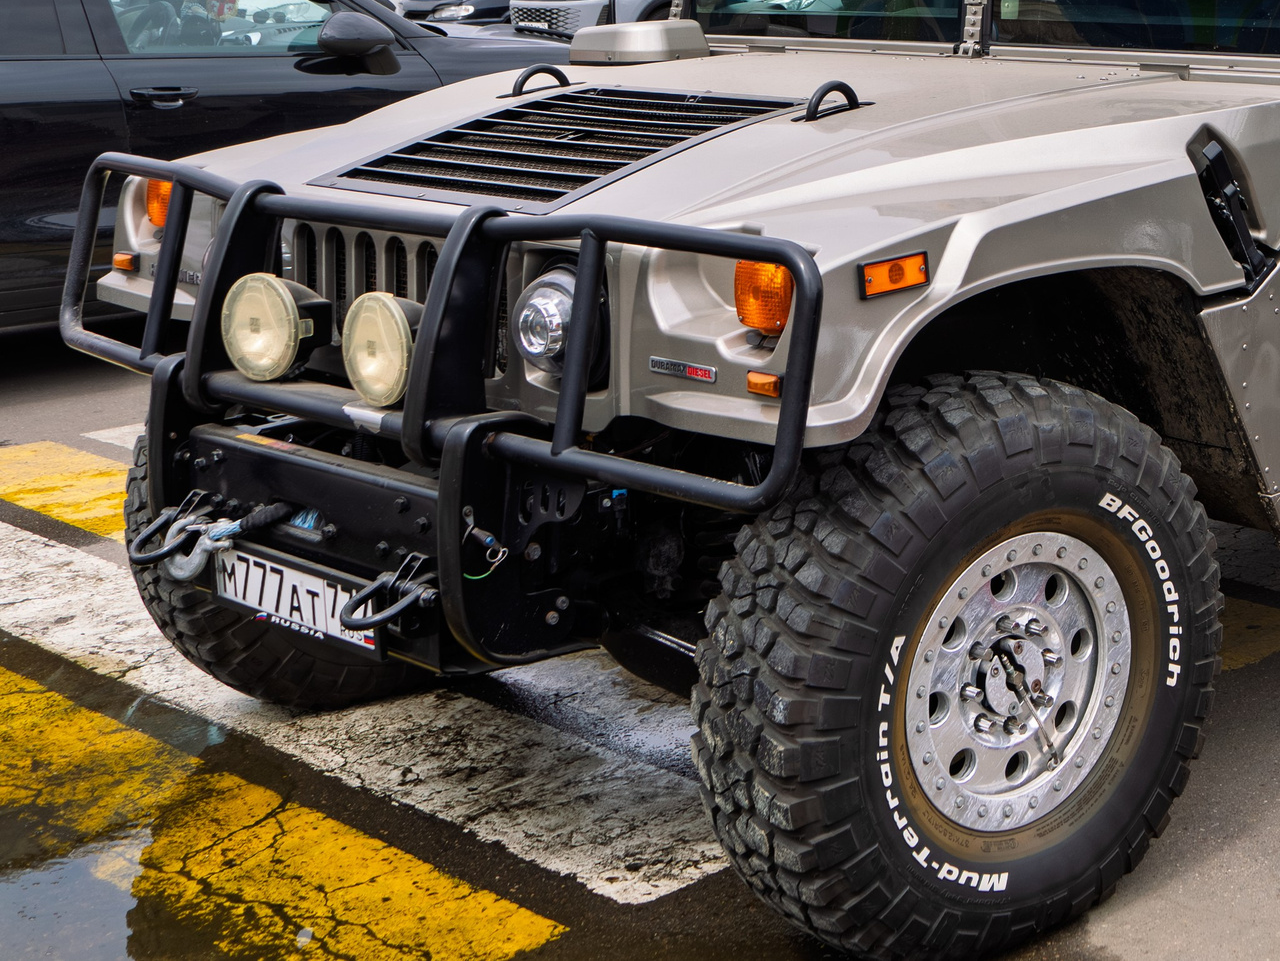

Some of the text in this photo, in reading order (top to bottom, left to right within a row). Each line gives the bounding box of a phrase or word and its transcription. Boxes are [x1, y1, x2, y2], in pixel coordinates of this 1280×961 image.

[686, 365, 713, 380] DIESEL
[270, 615, 325, 640] RUSSIA
[1098, 492, 1183, 688] BFGoodrich
[878, 635, 906, 712] T/A
[876, 721, 1009, 892] Mud-Terrain
